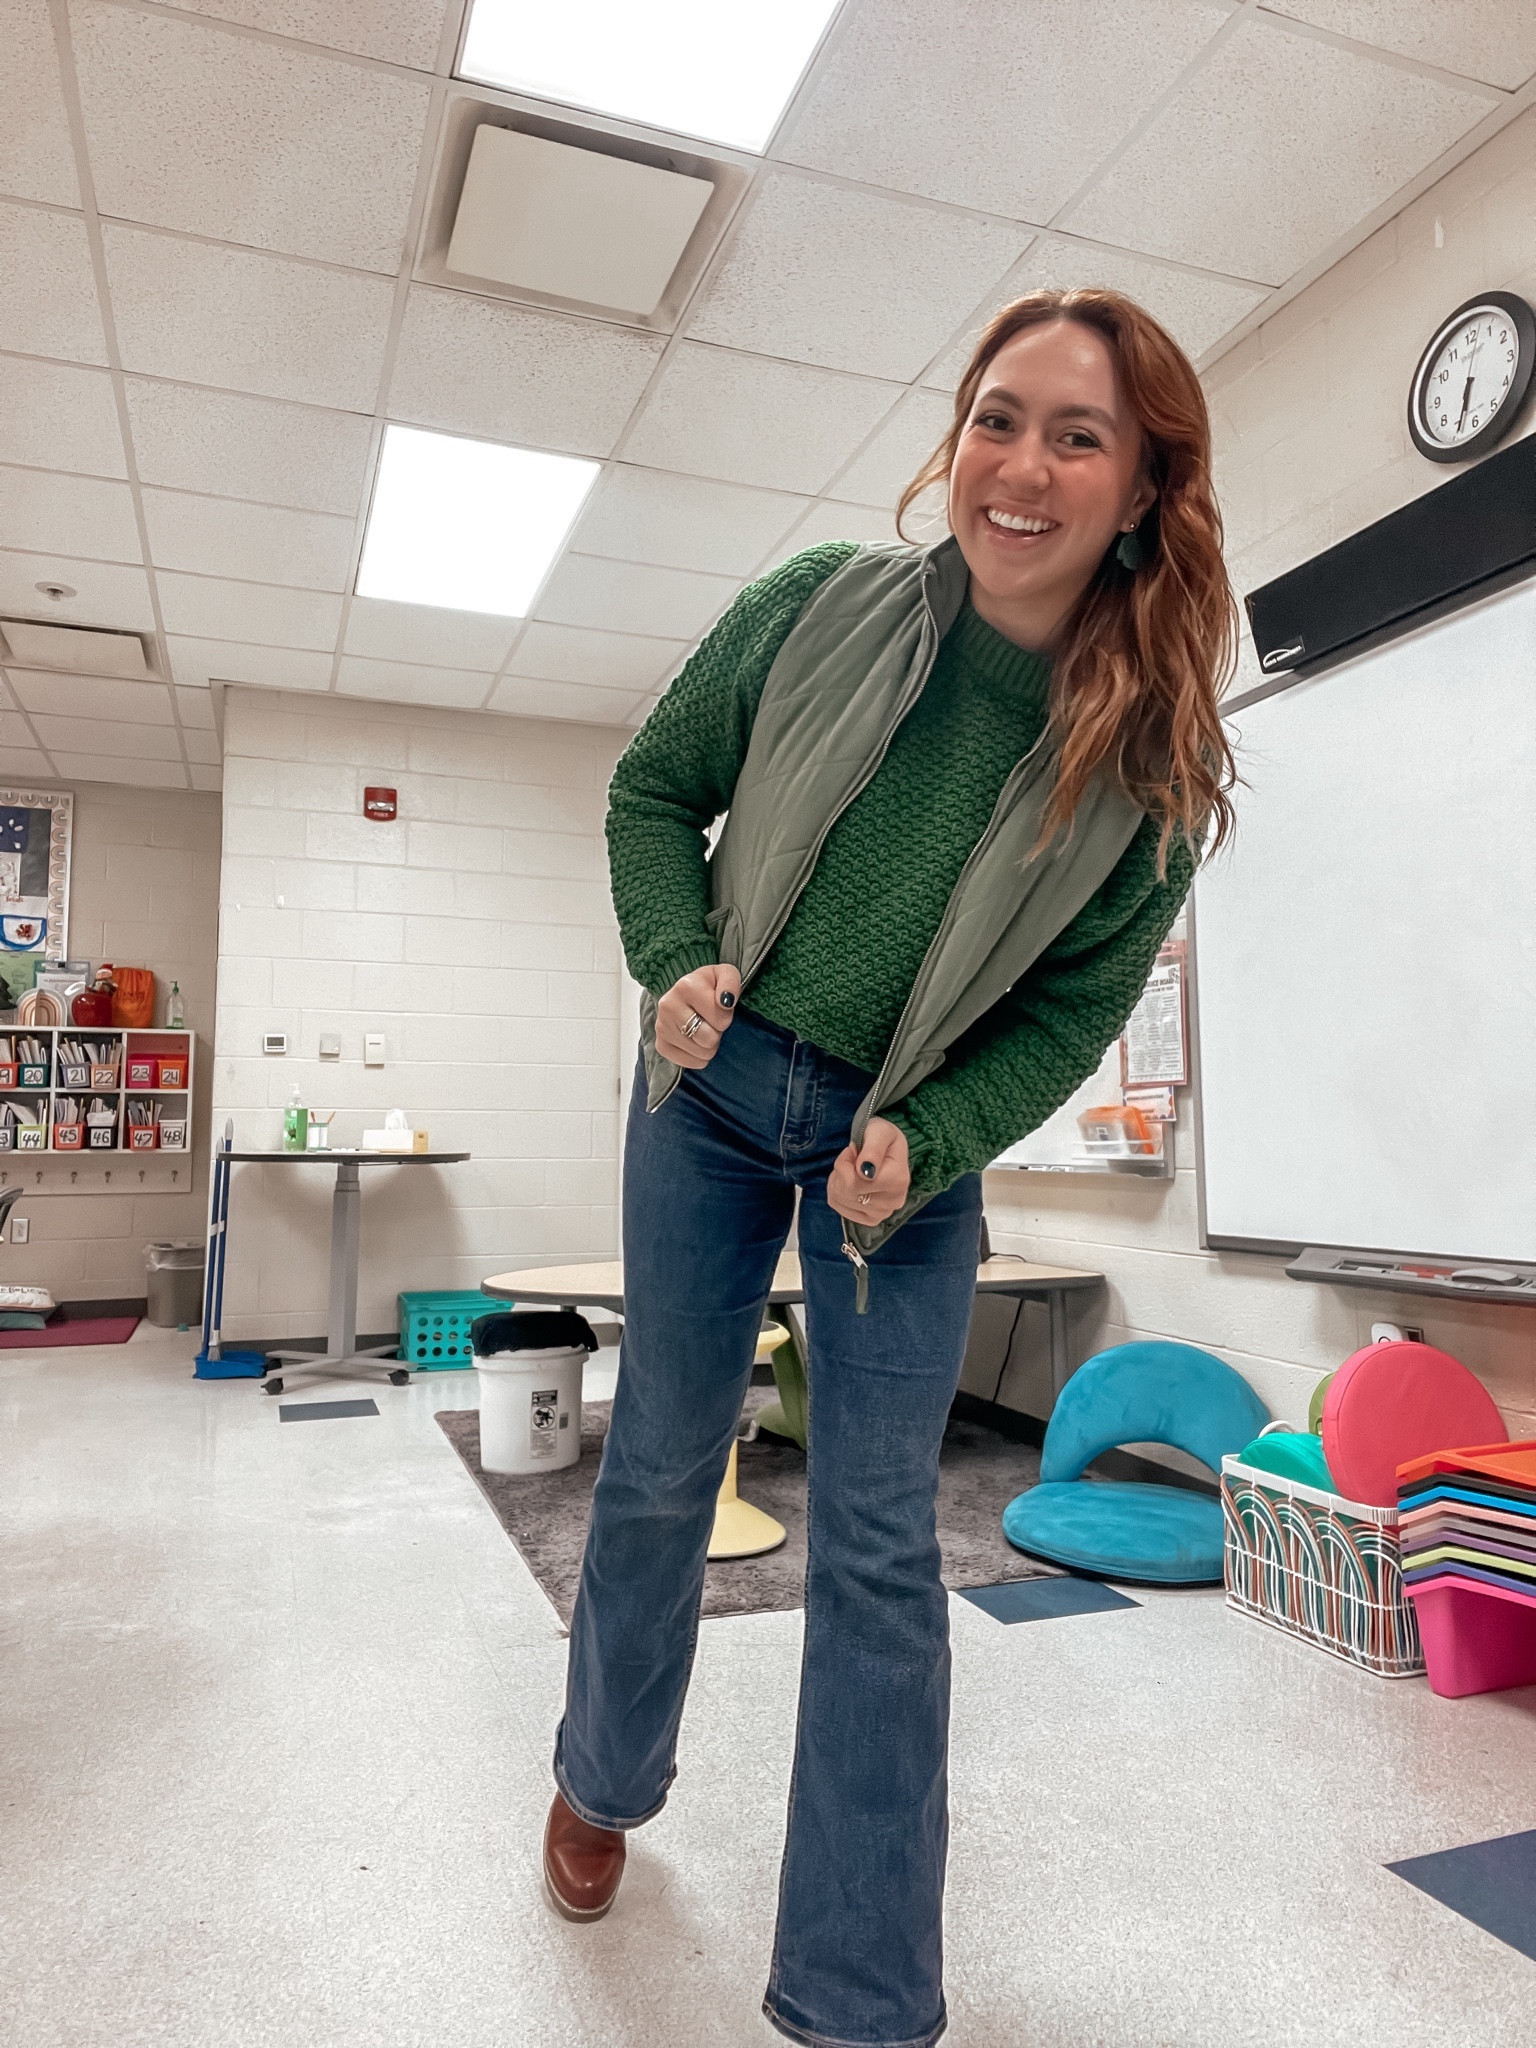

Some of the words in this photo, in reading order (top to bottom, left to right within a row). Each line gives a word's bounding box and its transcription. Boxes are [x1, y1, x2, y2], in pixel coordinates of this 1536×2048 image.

[1465, 330, 1476, 345] 12
[1487, 325, 1492, 337] 1
[1500, 330, 1508, 345] 2
[1448, 348, 1458, 363] 11
[1506, 349, 1515, 363] 3
[1438, 369, 1449, 385] 10
[1502, 375, 1509, 387] 4
[1434, 396, 1441, 410] 9
[1490, 398, 1498, 413] 5
[1440, 414, 1448, 427] 8
[1472, 415, 1479, 428] 6
[0, 1069, 10, 1084] 9
[24, 1070, 43, 1083] 20
[70, 1068, 84, 1082] 21
[95, 1072, 113, 1084] 22
[132, 1067, 150, 1079] 23
[163, 1071, 178, 1083] 24
[23, 1133, 40, 1147] 44
[60, 1129, 77, 1142] 45
[93, 1131, 110, 1144] 46
[135, 1132, 152, 1146] 47
[164, 1130, 181, 1143] 48
